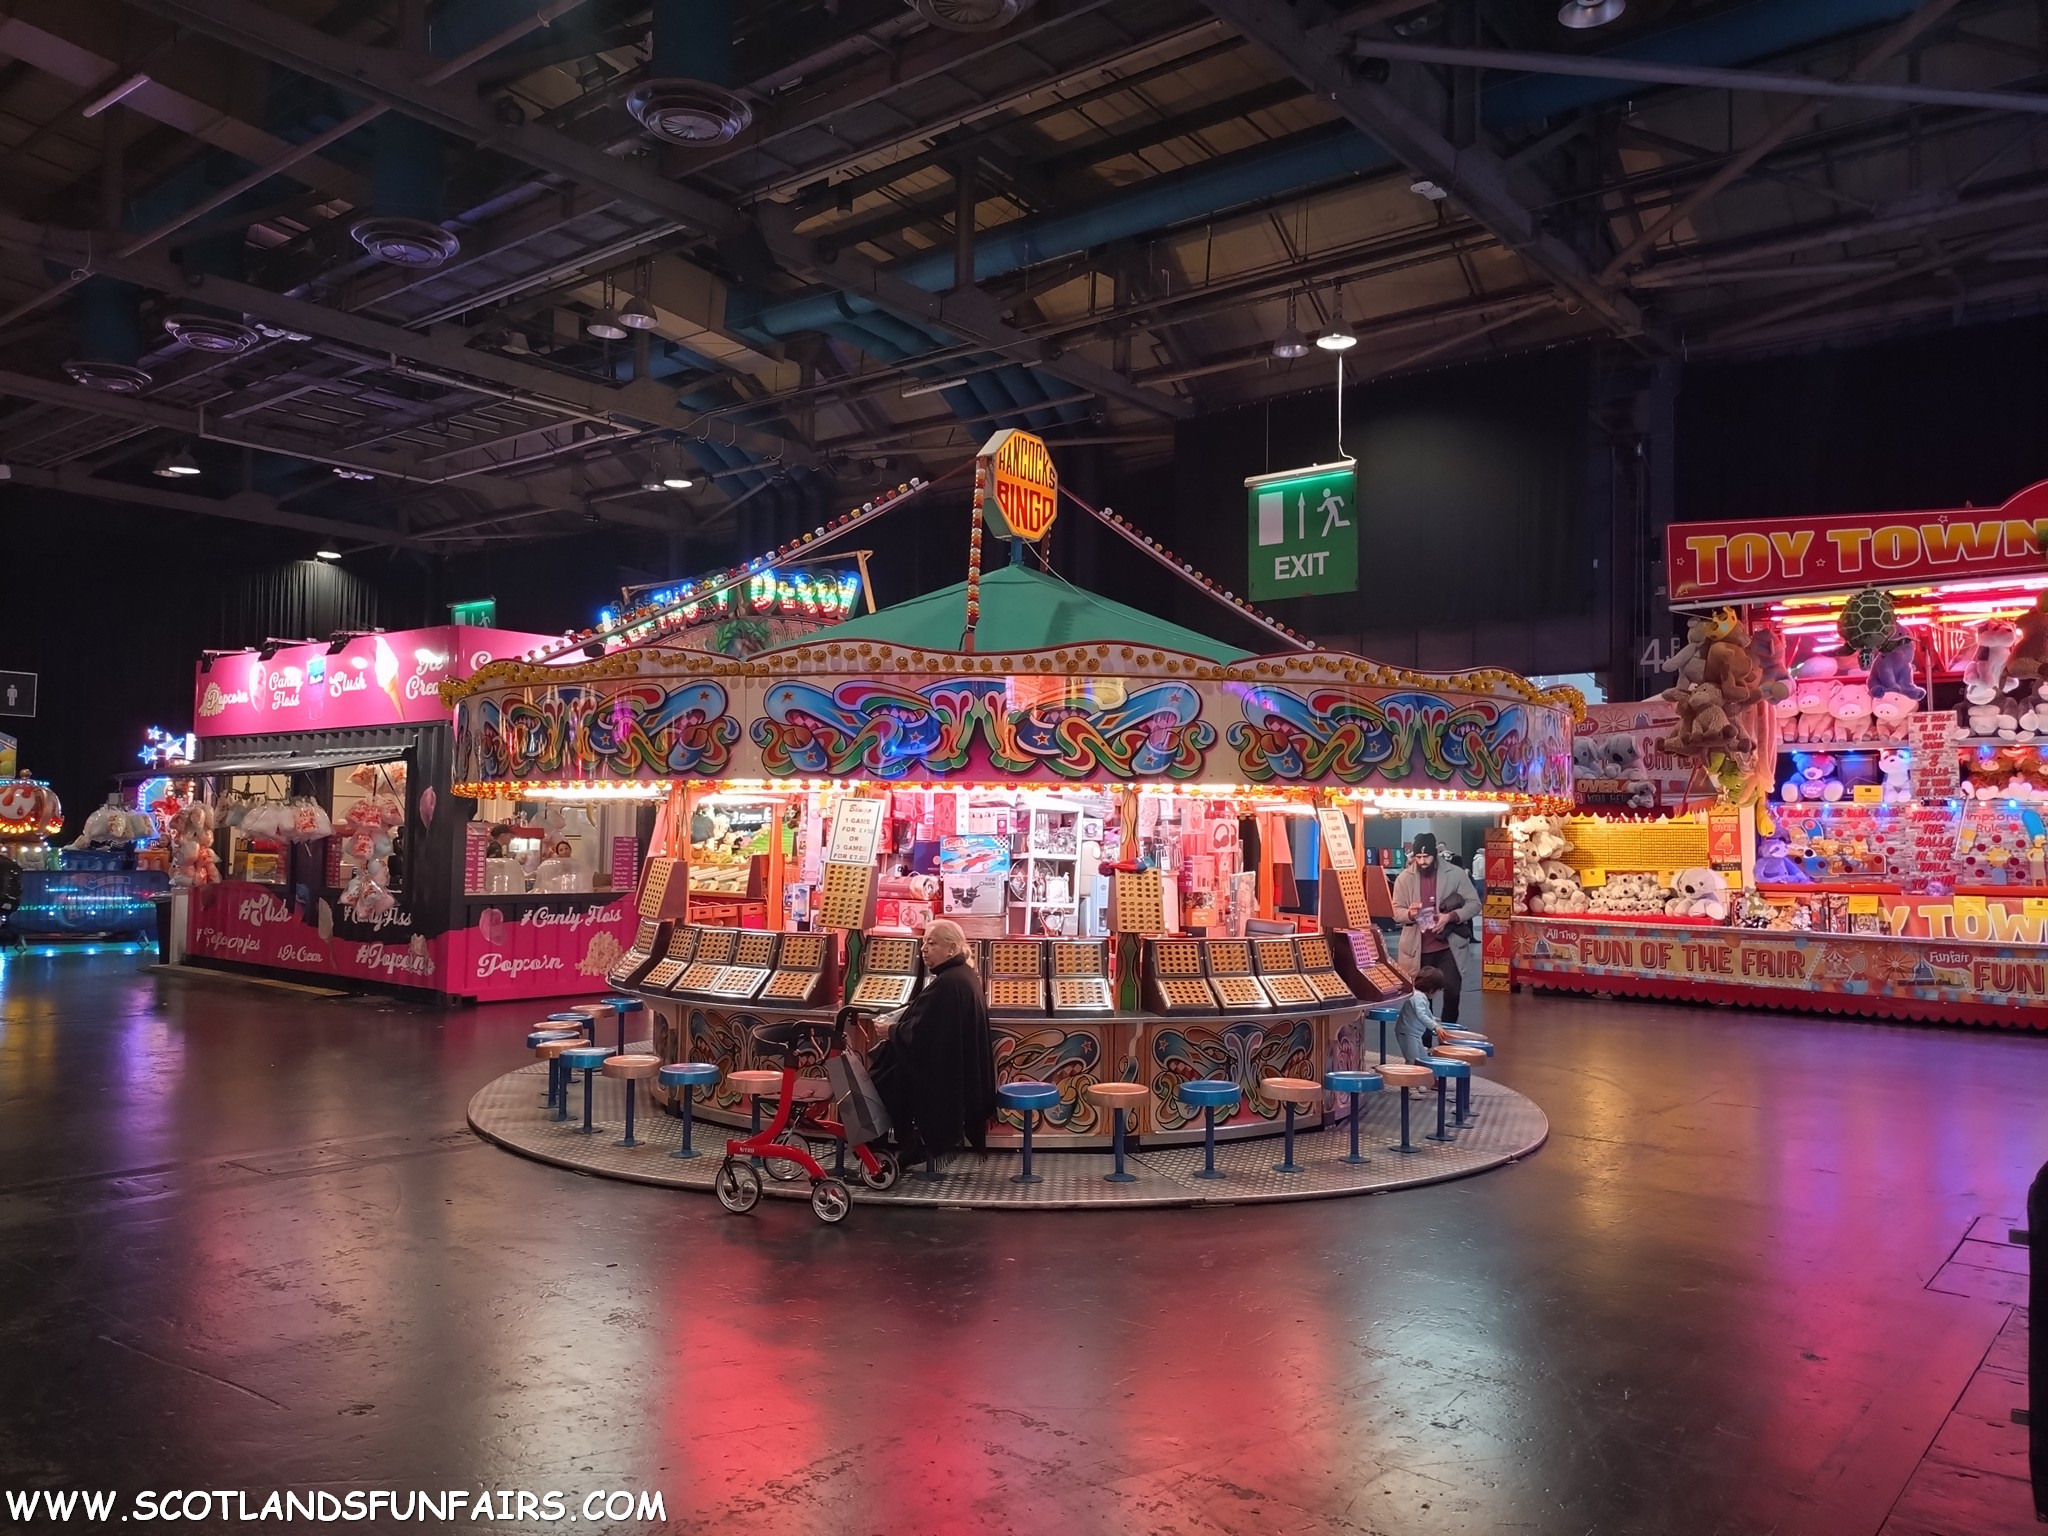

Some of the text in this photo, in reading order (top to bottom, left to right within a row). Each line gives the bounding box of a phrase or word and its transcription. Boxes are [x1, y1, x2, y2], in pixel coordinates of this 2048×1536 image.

[998, 435, 1055, 490] HANCOCKS
[997, 480, 1054, 532] BINGO
[1686, 519, 2048, 586] TOY TOWN
[1274, 551, 1329, 580] EXIT
[329, 671, 367, 697] Slush
[207, 689, 249, 712] Popcorn
[271, 691, 300, 714] Floss
[1920, 767, 1949, 777] BALLS
[1577, 779, 1618, 793] OVER
[1912, 810, 1955, 822] THROW
[1966, 813, 2021, 822] impsons
[1922, 824, 1945, 835] THE
[1976, 823, 2003, 833] Rule
[1714, 832, 1734, 855] 4
[1914, 837, 1955, 847] BALLS
[1915, 851, 1929, 860] IN
[1490, 858, 1508, 880] 4
[1920, 863, 1950, 872] WALL
[584, 904, 623, 926] Floss
[1487, 934, 1505, 957] 4
[1545, 928, 1577, 941] All The
[476, 953, 564, 979] Popcorn
[1579, 938, 1806, 980] FUN OF THE FAIR
[1929, 951, 1971, 964] Funfair
[1973, 961, 2045, 995] FUN
